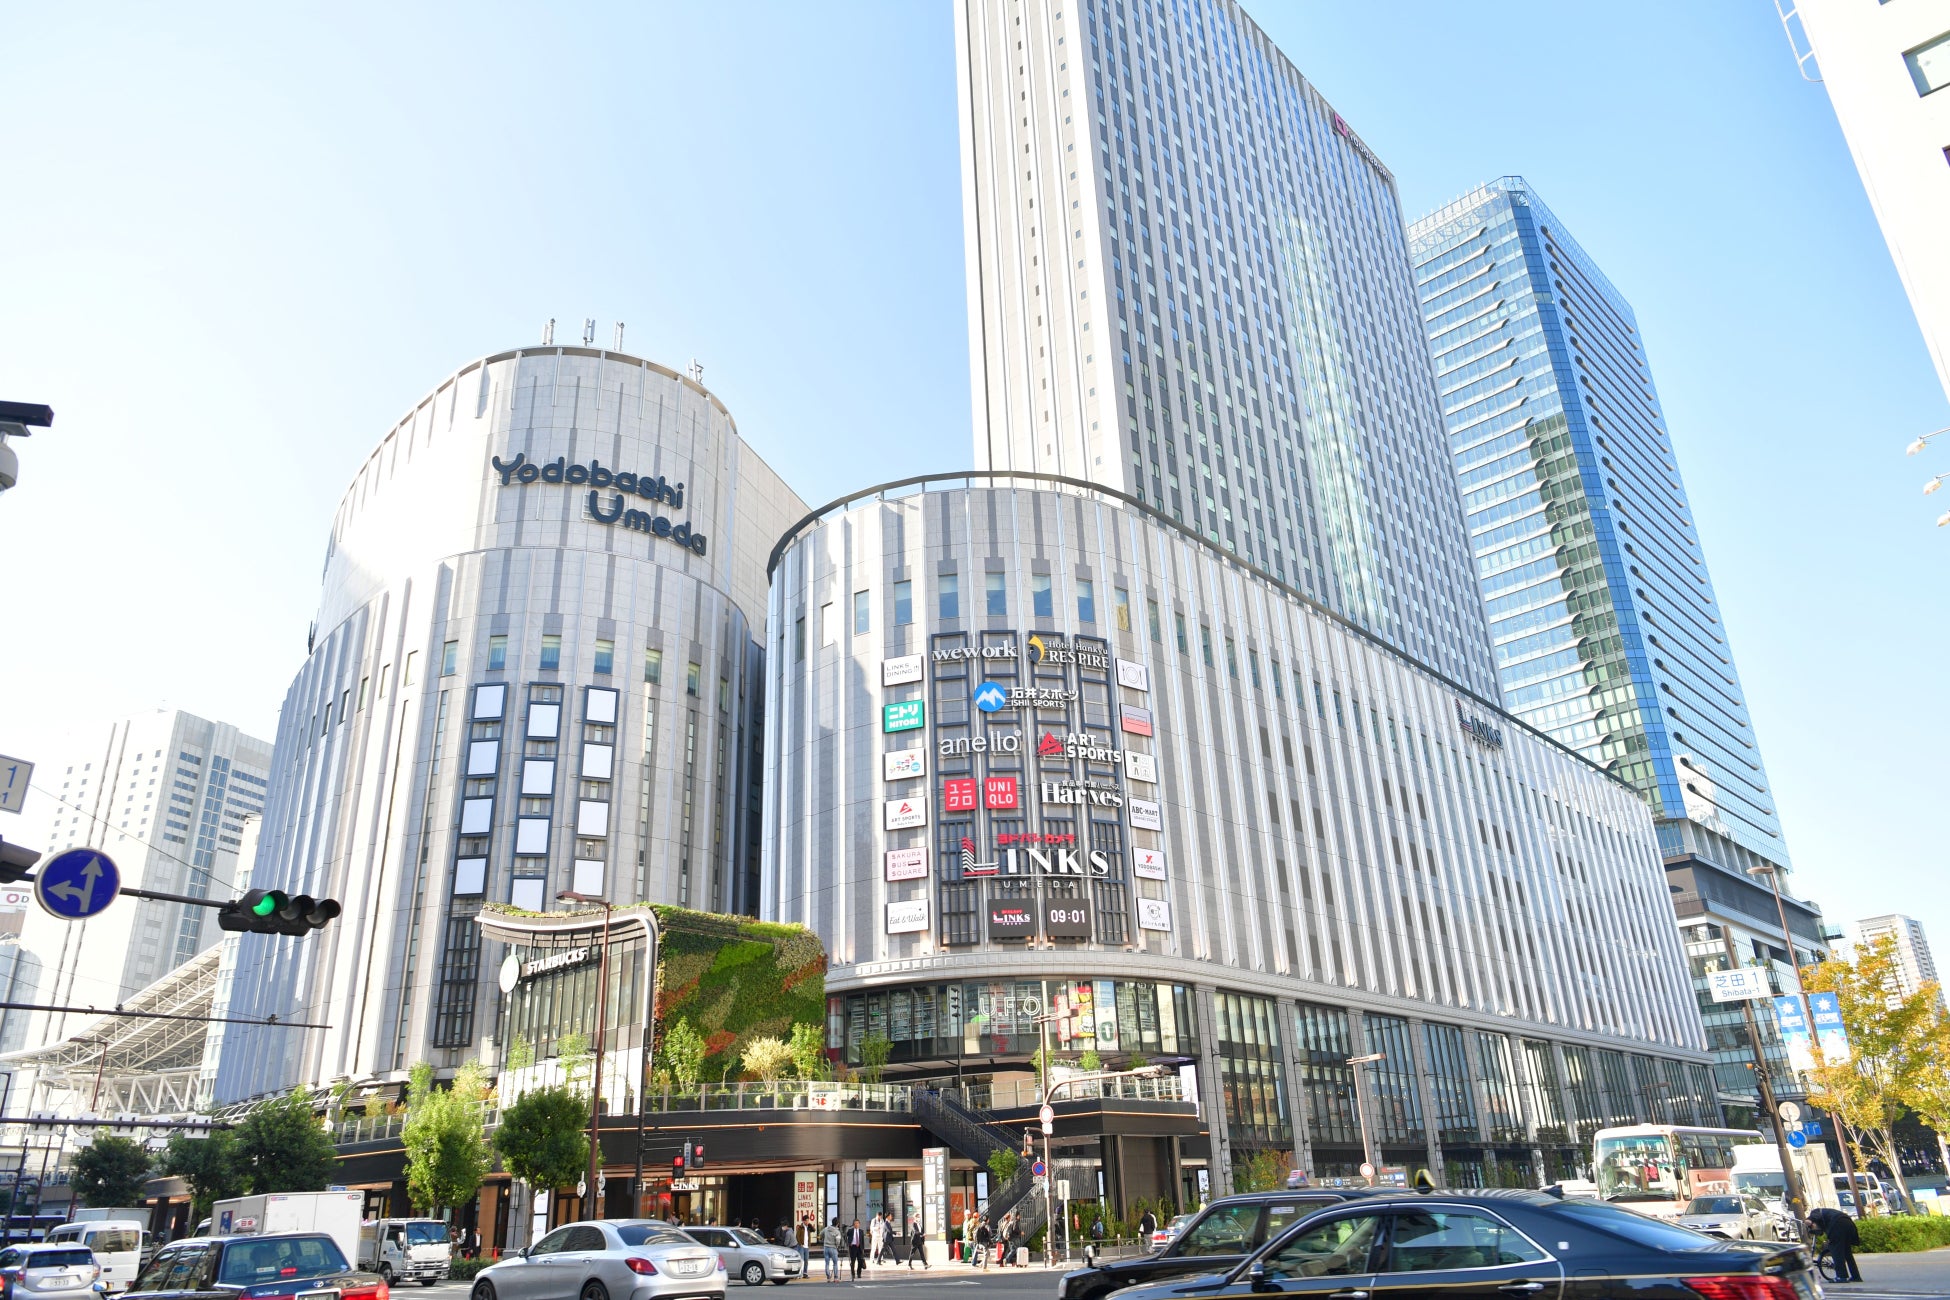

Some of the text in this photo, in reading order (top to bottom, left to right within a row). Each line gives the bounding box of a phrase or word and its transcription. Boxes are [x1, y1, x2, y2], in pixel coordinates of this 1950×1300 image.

[491, 452, 685, 510] Yodobashi
[588, 489, 707, 557] Umeda
[932, 639, 1018, 661] wework
[1048, 640, 1108, 655] Hotel Hankyu
[1049, 649, 1110, 669] RESPIRE
[886, 662, 910, 672] LINKS
[886, 668, 913, 678] DINING
[1011, 687, 1079, 701] 石井スポーツ
[1011, 699, 1066, 708] ISHII SPORTS
[888, 703, 919, 720] ニトリ
[888, 717, 919, 729] NITORI
[1067, 732, 1097, 747] ART
[1066, 745, 1122, 763] SPORTS
[7, 765, 18, 788] 1
[1041, 781, 1124, 808] Harves
[1131, 805, 1158, 817] ABC-MART
[891, 851, 922, 860] SAKURA
[960, 836, 1109, 876] LINKS
[891, 869, 922, 877] SQUARE
[1003, 880, 1075, 889] UMEDA
[992, 911, 1031, 923] LINKS
[1050, 909, 1086, 923] 09:01
[526, 947, 589, 976] STARBUCKS
[1714, 970, 1759, 988] 芝田 1
[1721, 986, 1760, 998] Shibata-1
